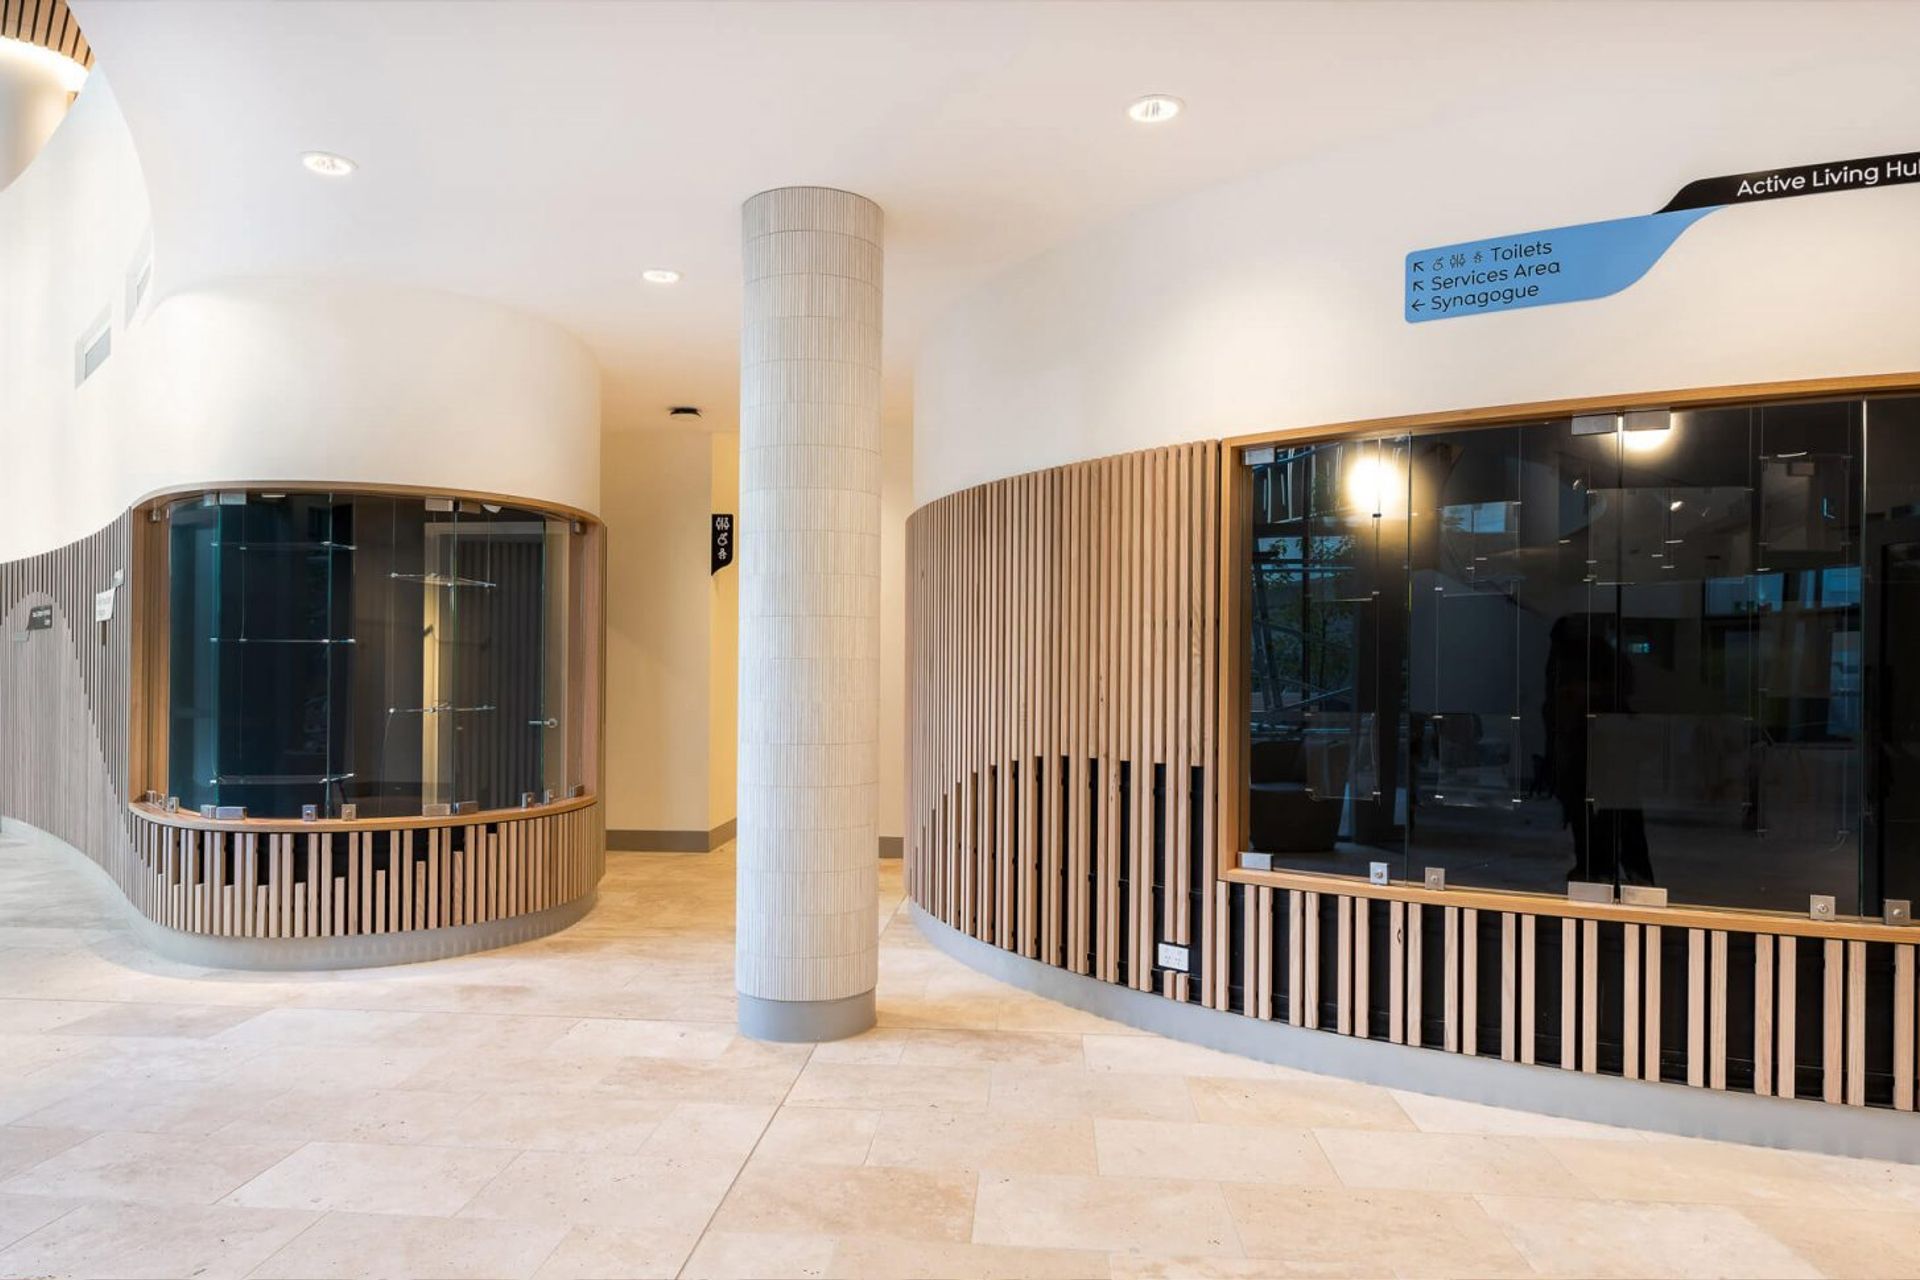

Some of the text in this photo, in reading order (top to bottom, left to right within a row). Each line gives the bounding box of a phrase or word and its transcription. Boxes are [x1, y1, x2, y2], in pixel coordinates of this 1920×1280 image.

[1737, 158, 1920, 197] Active Living Hu
[1490, 241, 1553, 262] Toilets
[1431, 262, 1561, 291] Services Area
[1431, 284, 1539, 312] Synagogue
